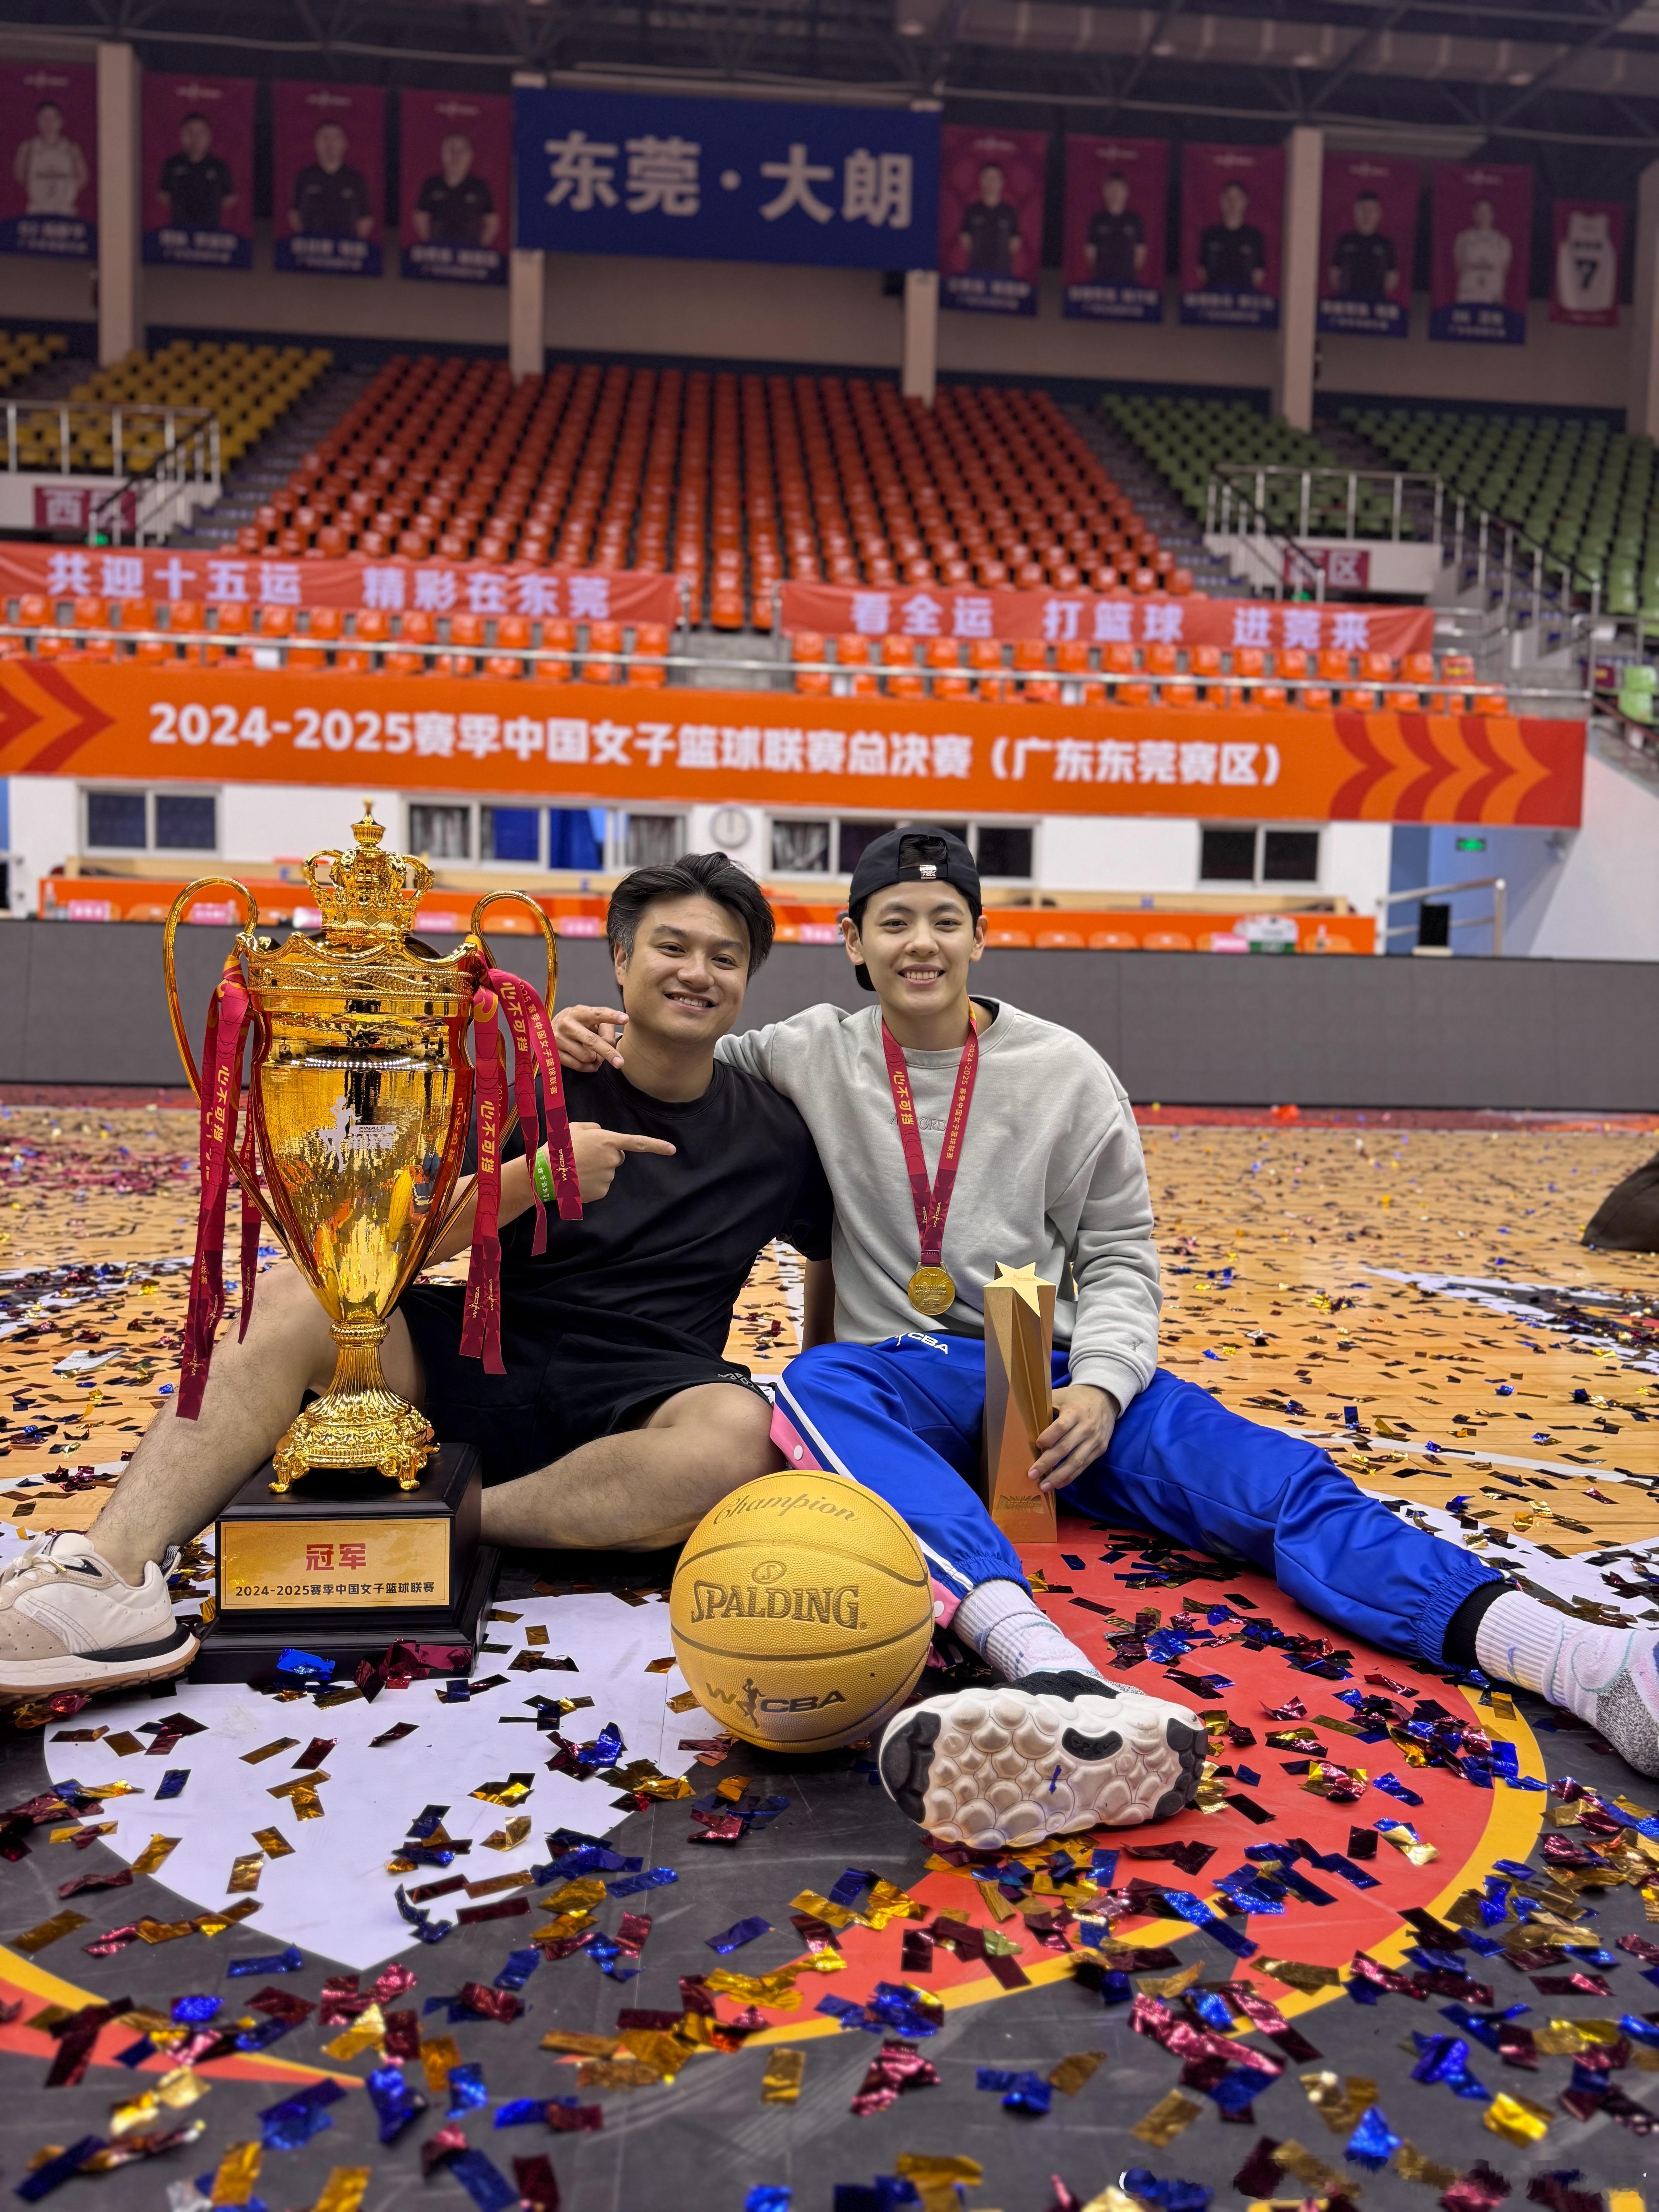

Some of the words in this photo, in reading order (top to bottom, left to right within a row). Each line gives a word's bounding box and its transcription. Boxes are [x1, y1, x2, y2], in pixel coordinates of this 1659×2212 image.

[544, 131, 913, 228] 东莞·大朗
[47, 552, 302, 605] 共迎十五运
[362, 566, 610, 619] 精彩在东莞
[1043, 598, 1183, 644] 打篮球
[500, 982, 528, 1052] 心不可挡
[527, 1004, 558, 1095] 赛季中国女子篮球联赛
[962, 1044, 975, 1085] 2024-2025
[213, 1065, 230, 1142] 心不可挡
[893, 1071, 914, 1125] 心不可挡
[480, 1100, 495, 1174] 心不可挡
[713, 1493, 860, 1525] Champion
[306, 1543, 366, 1571] 冠军
[235, 1581, 434, 1596] 2024-2025赛季中国女子篮球联赛
[691, 1580, 860, 1630] SPALDING
